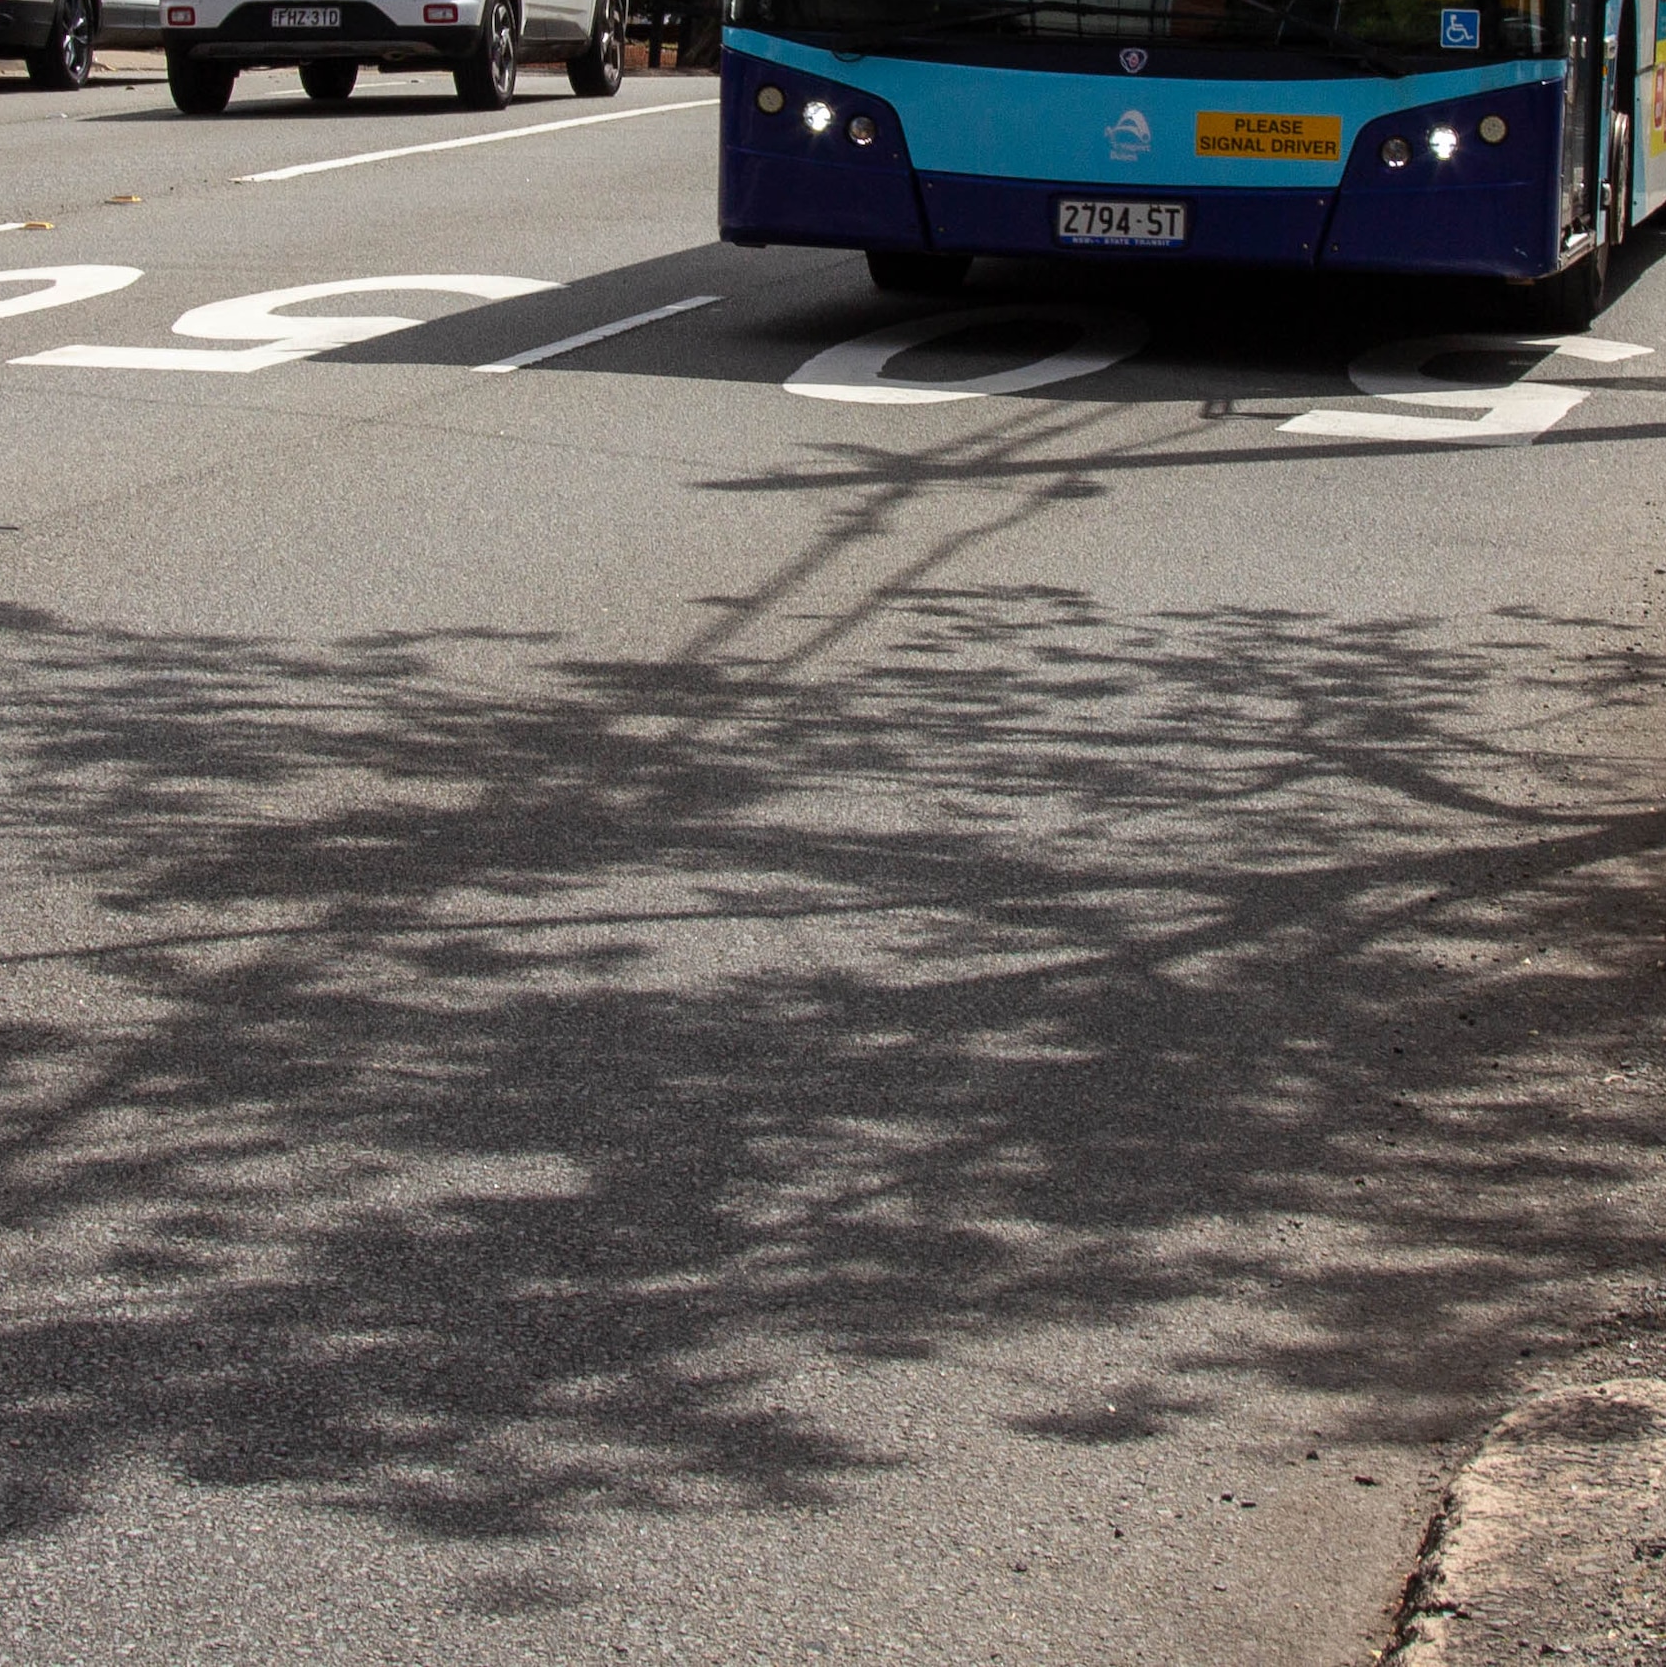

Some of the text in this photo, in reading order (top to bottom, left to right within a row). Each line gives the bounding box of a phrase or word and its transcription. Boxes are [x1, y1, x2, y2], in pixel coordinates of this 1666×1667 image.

[1234, 118, 1303, 135] PLEASE
[1199, 136, 1337, 155] SIGNAL DRIVER
[1104, 237, 1130, 245] STATE
